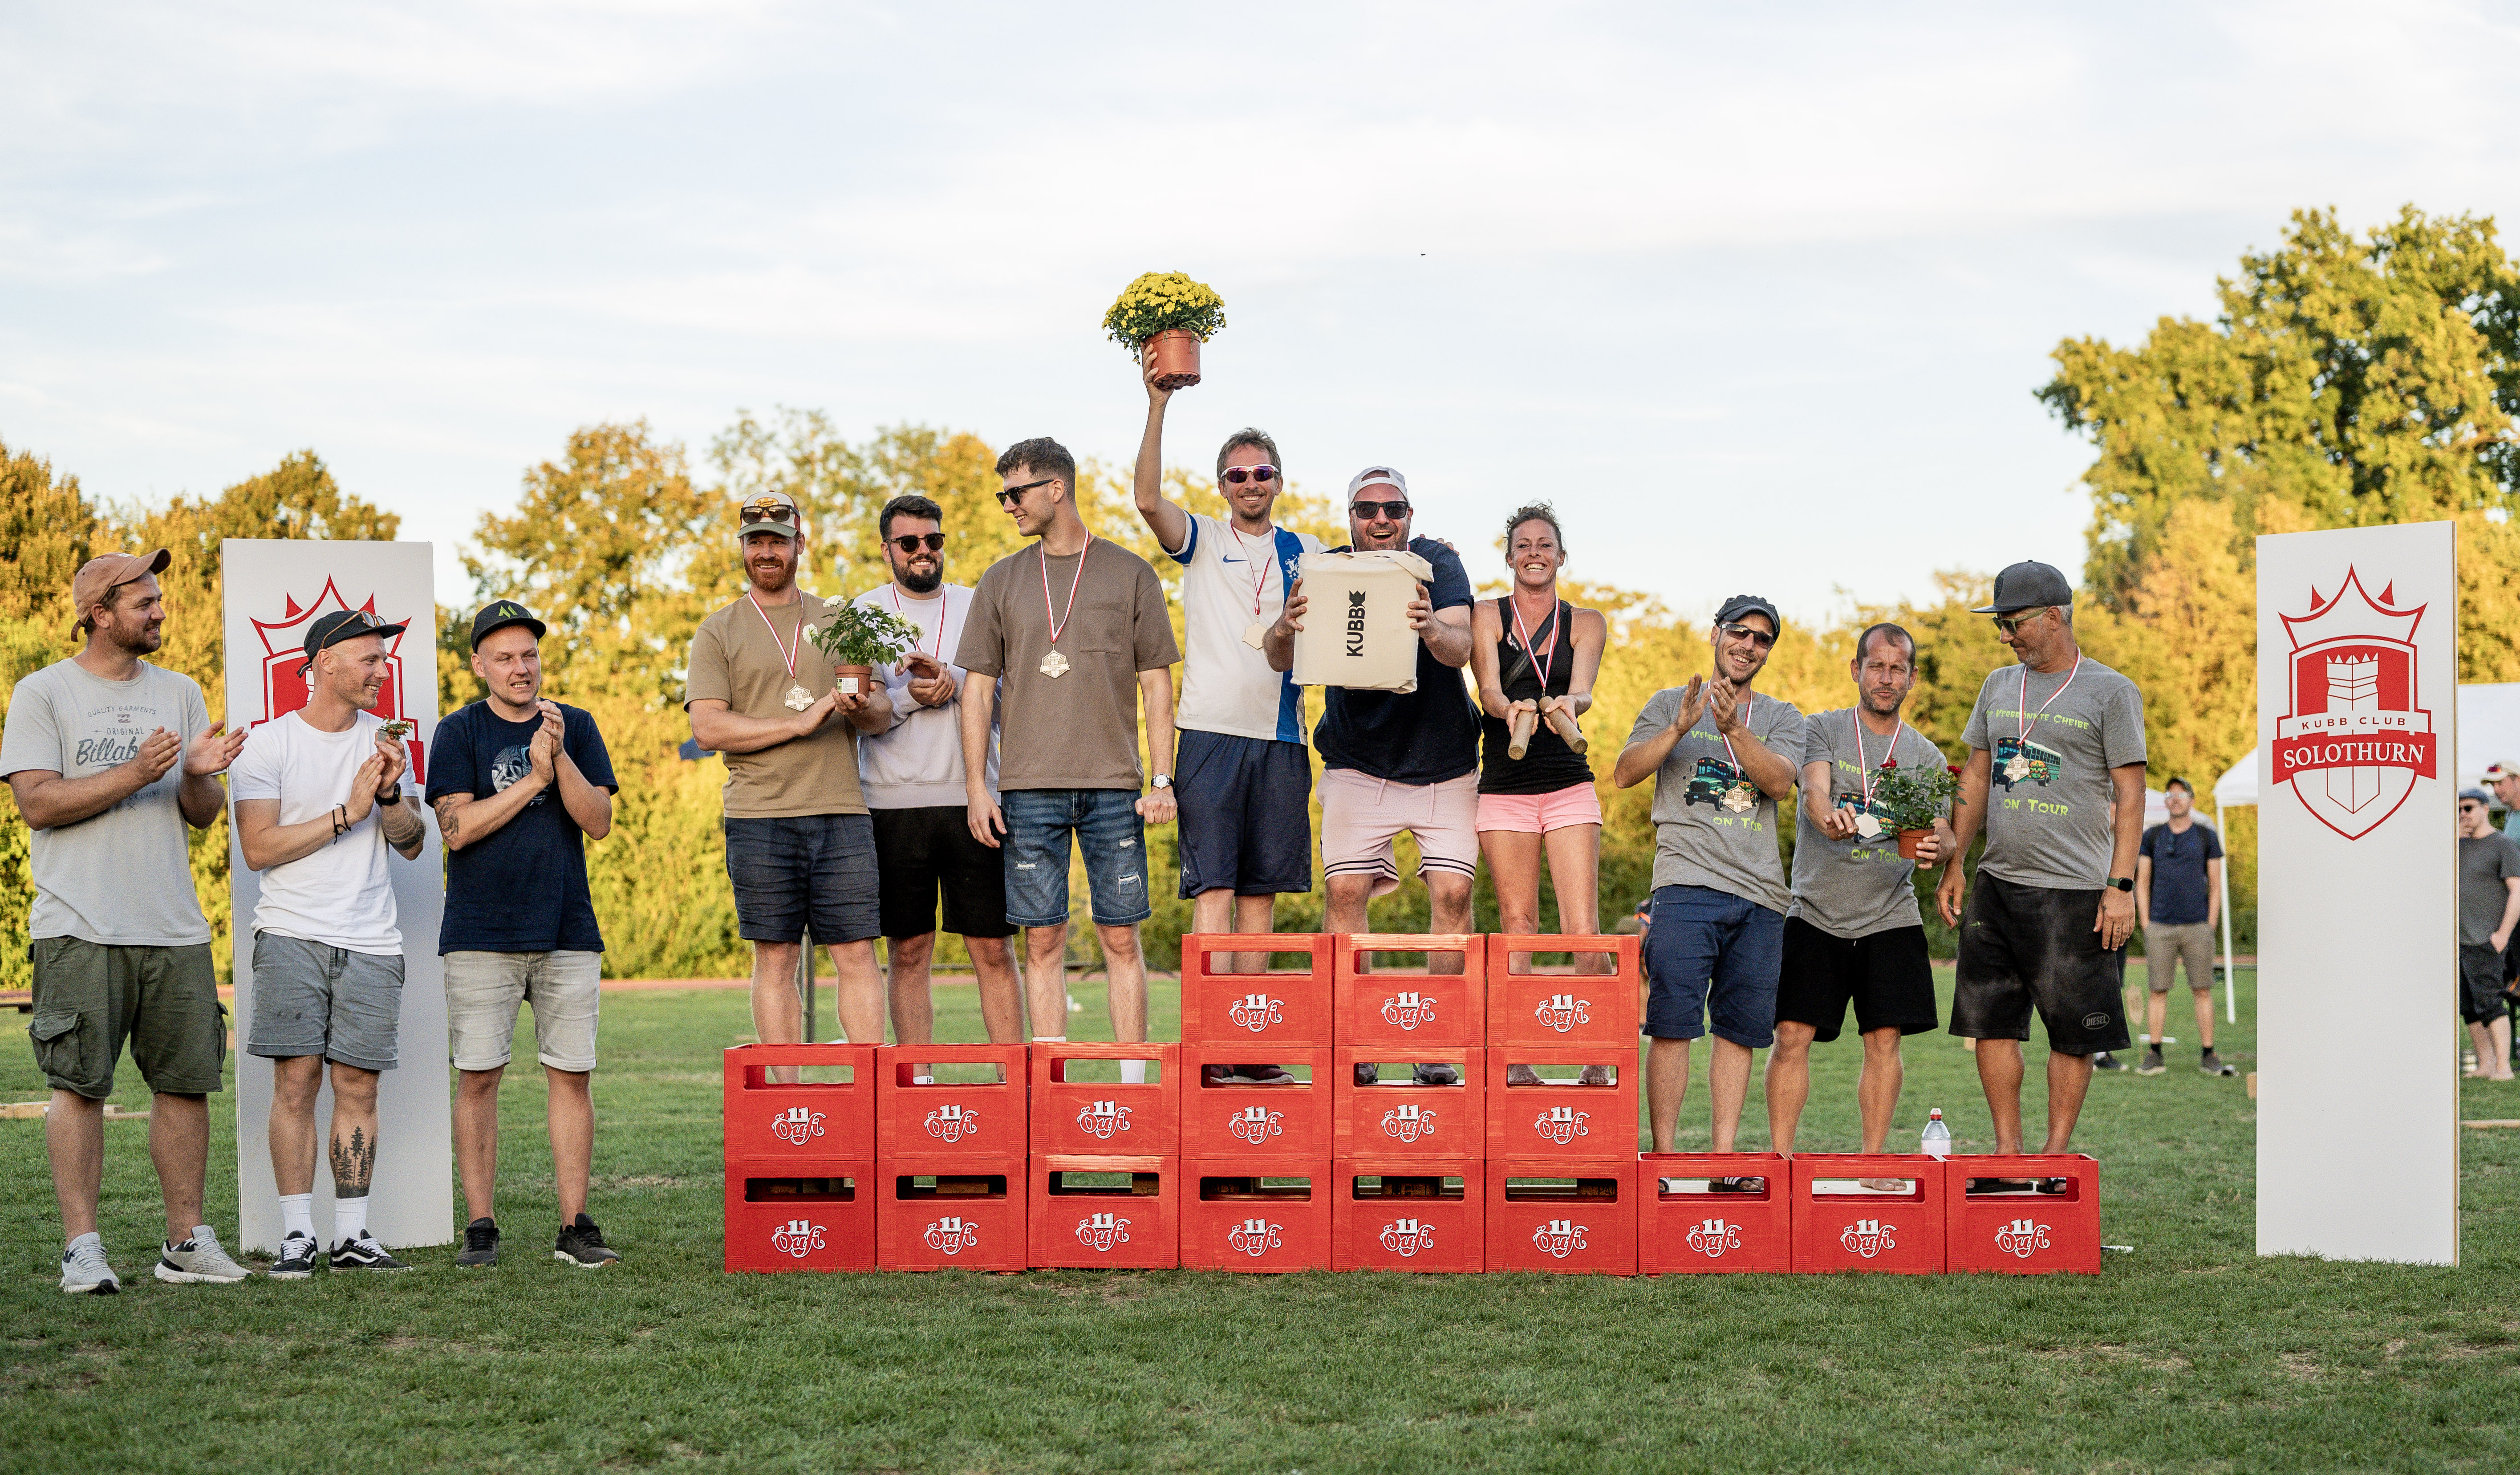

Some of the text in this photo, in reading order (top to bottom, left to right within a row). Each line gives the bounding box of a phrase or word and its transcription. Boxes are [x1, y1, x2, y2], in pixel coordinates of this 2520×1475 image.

[1347, 607, 1365, 657] KUBB
[88, 706, 157, 717] QUALITY GARMENTS
[107, 727, 144, 735] ORIGINAL
[2302, 717, 2406, 730] KUBB CLUB
[76, 735, 139, 766] Billab
[2284, 742, 2425, 768] SOLOTHURN
[2004, 798, 2069, 816] ON TOUR
[1713, 817, 1733, 826] ON
[1851, 849, 1871, 860] ON
[1245, 994, 1266, 1009] 11
[1398, 992, 1419, 1007] 11
[1551, 994, 1573, 1009] 11
[2086, 1015, 2107, 1026] DIESEL
[787, 1107, 809, 1122] 11
[940, 1105, 961, 1120] 11
[1093, 1101, 1114, 1116] 11
[1245, 1106, 1266, 1121] 11
[1397, 1104, 1419, 1119] 11
[1551, 1106, 1572, 1121] 11
[788, 1219, 809, 1235] 11
[940, 1216, 961, 1231] 11
[1092, 1213, 1113, 1228] 11
[1244, 1219, 1266, 1234] 11
[1396, 1219, 1417, 1234] 11
[1549, 1219, 1570, 1235] 11
[1703, 1219, 1724, 1234] 11
[1857, 1219, 1879, 1235] 11
[2012, 1219, 2033, 1235] 11
